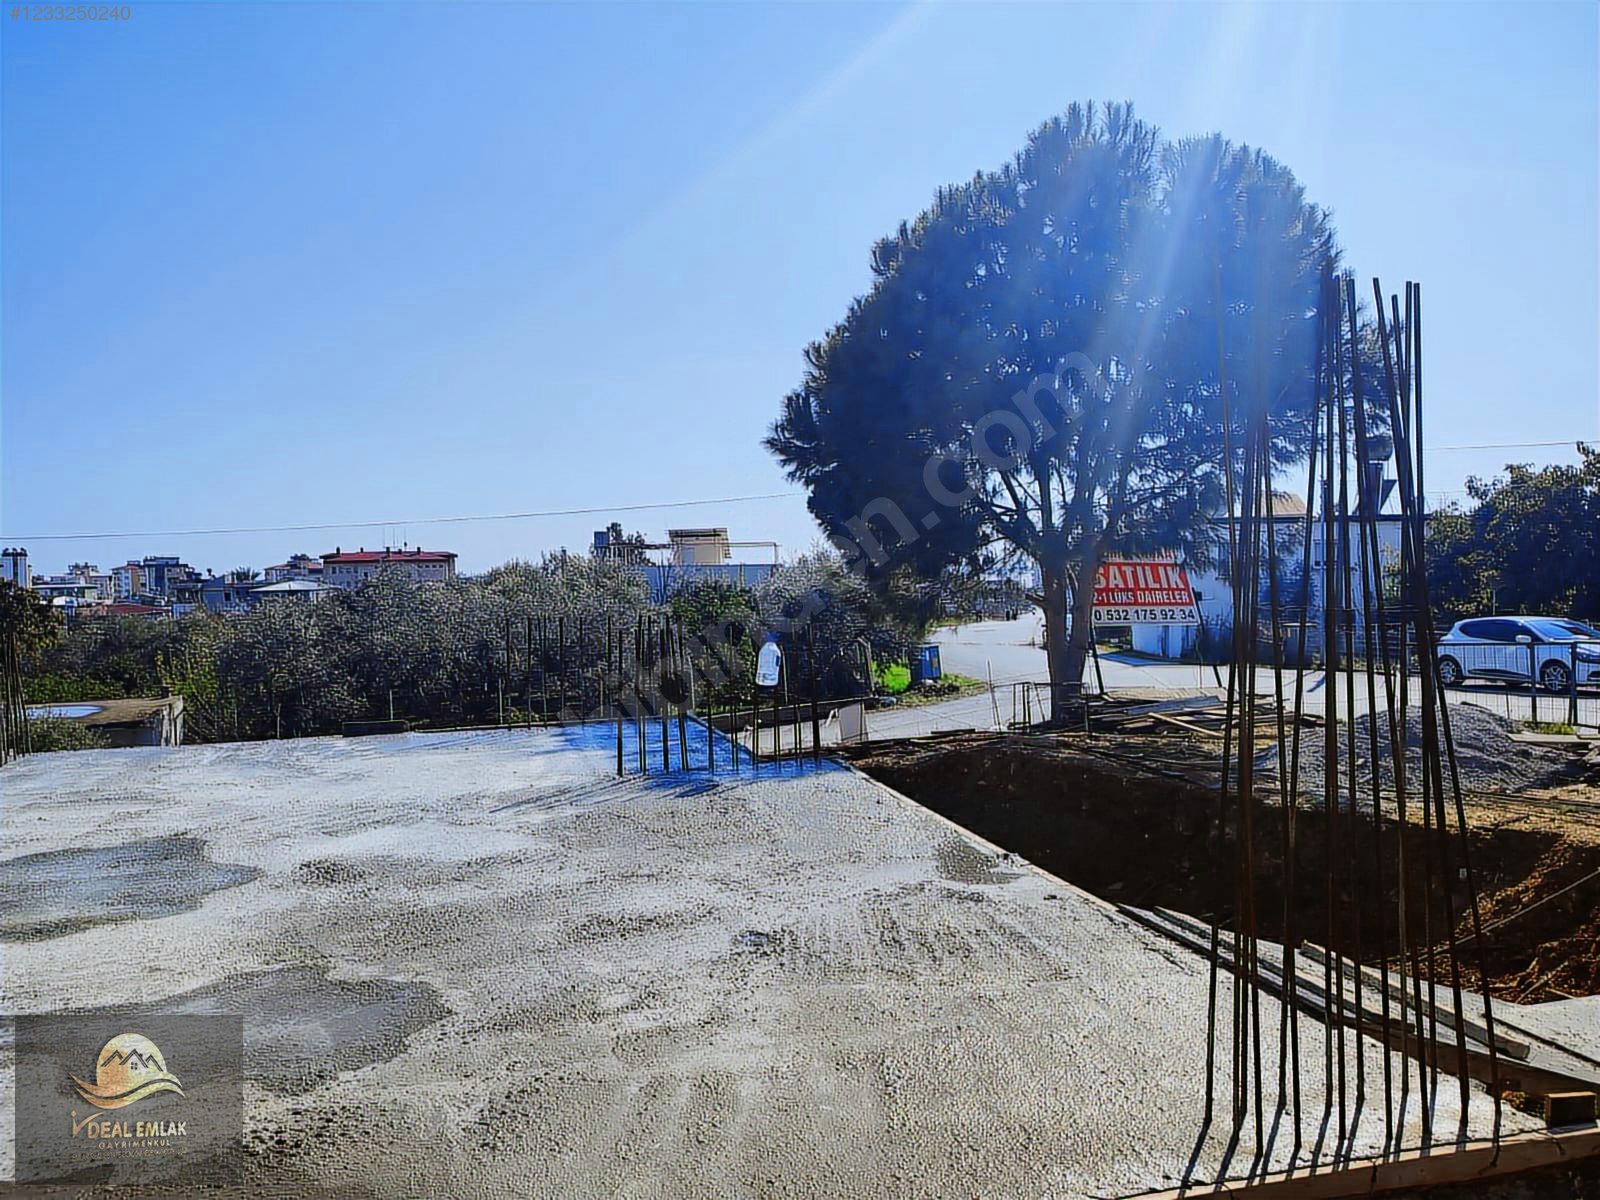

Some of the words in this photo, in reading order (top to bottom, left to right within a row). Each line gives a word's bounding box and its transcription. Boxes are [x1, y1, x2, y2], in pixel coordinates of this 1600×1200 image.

[1094, 609, 1102, 621] 0
[1106, 609, 1130, 621] 532
[1134, 609, 1157, 621] 175
[1160, 609, 1177, 621] 92
[1180, 609, 1195, 620] 34
